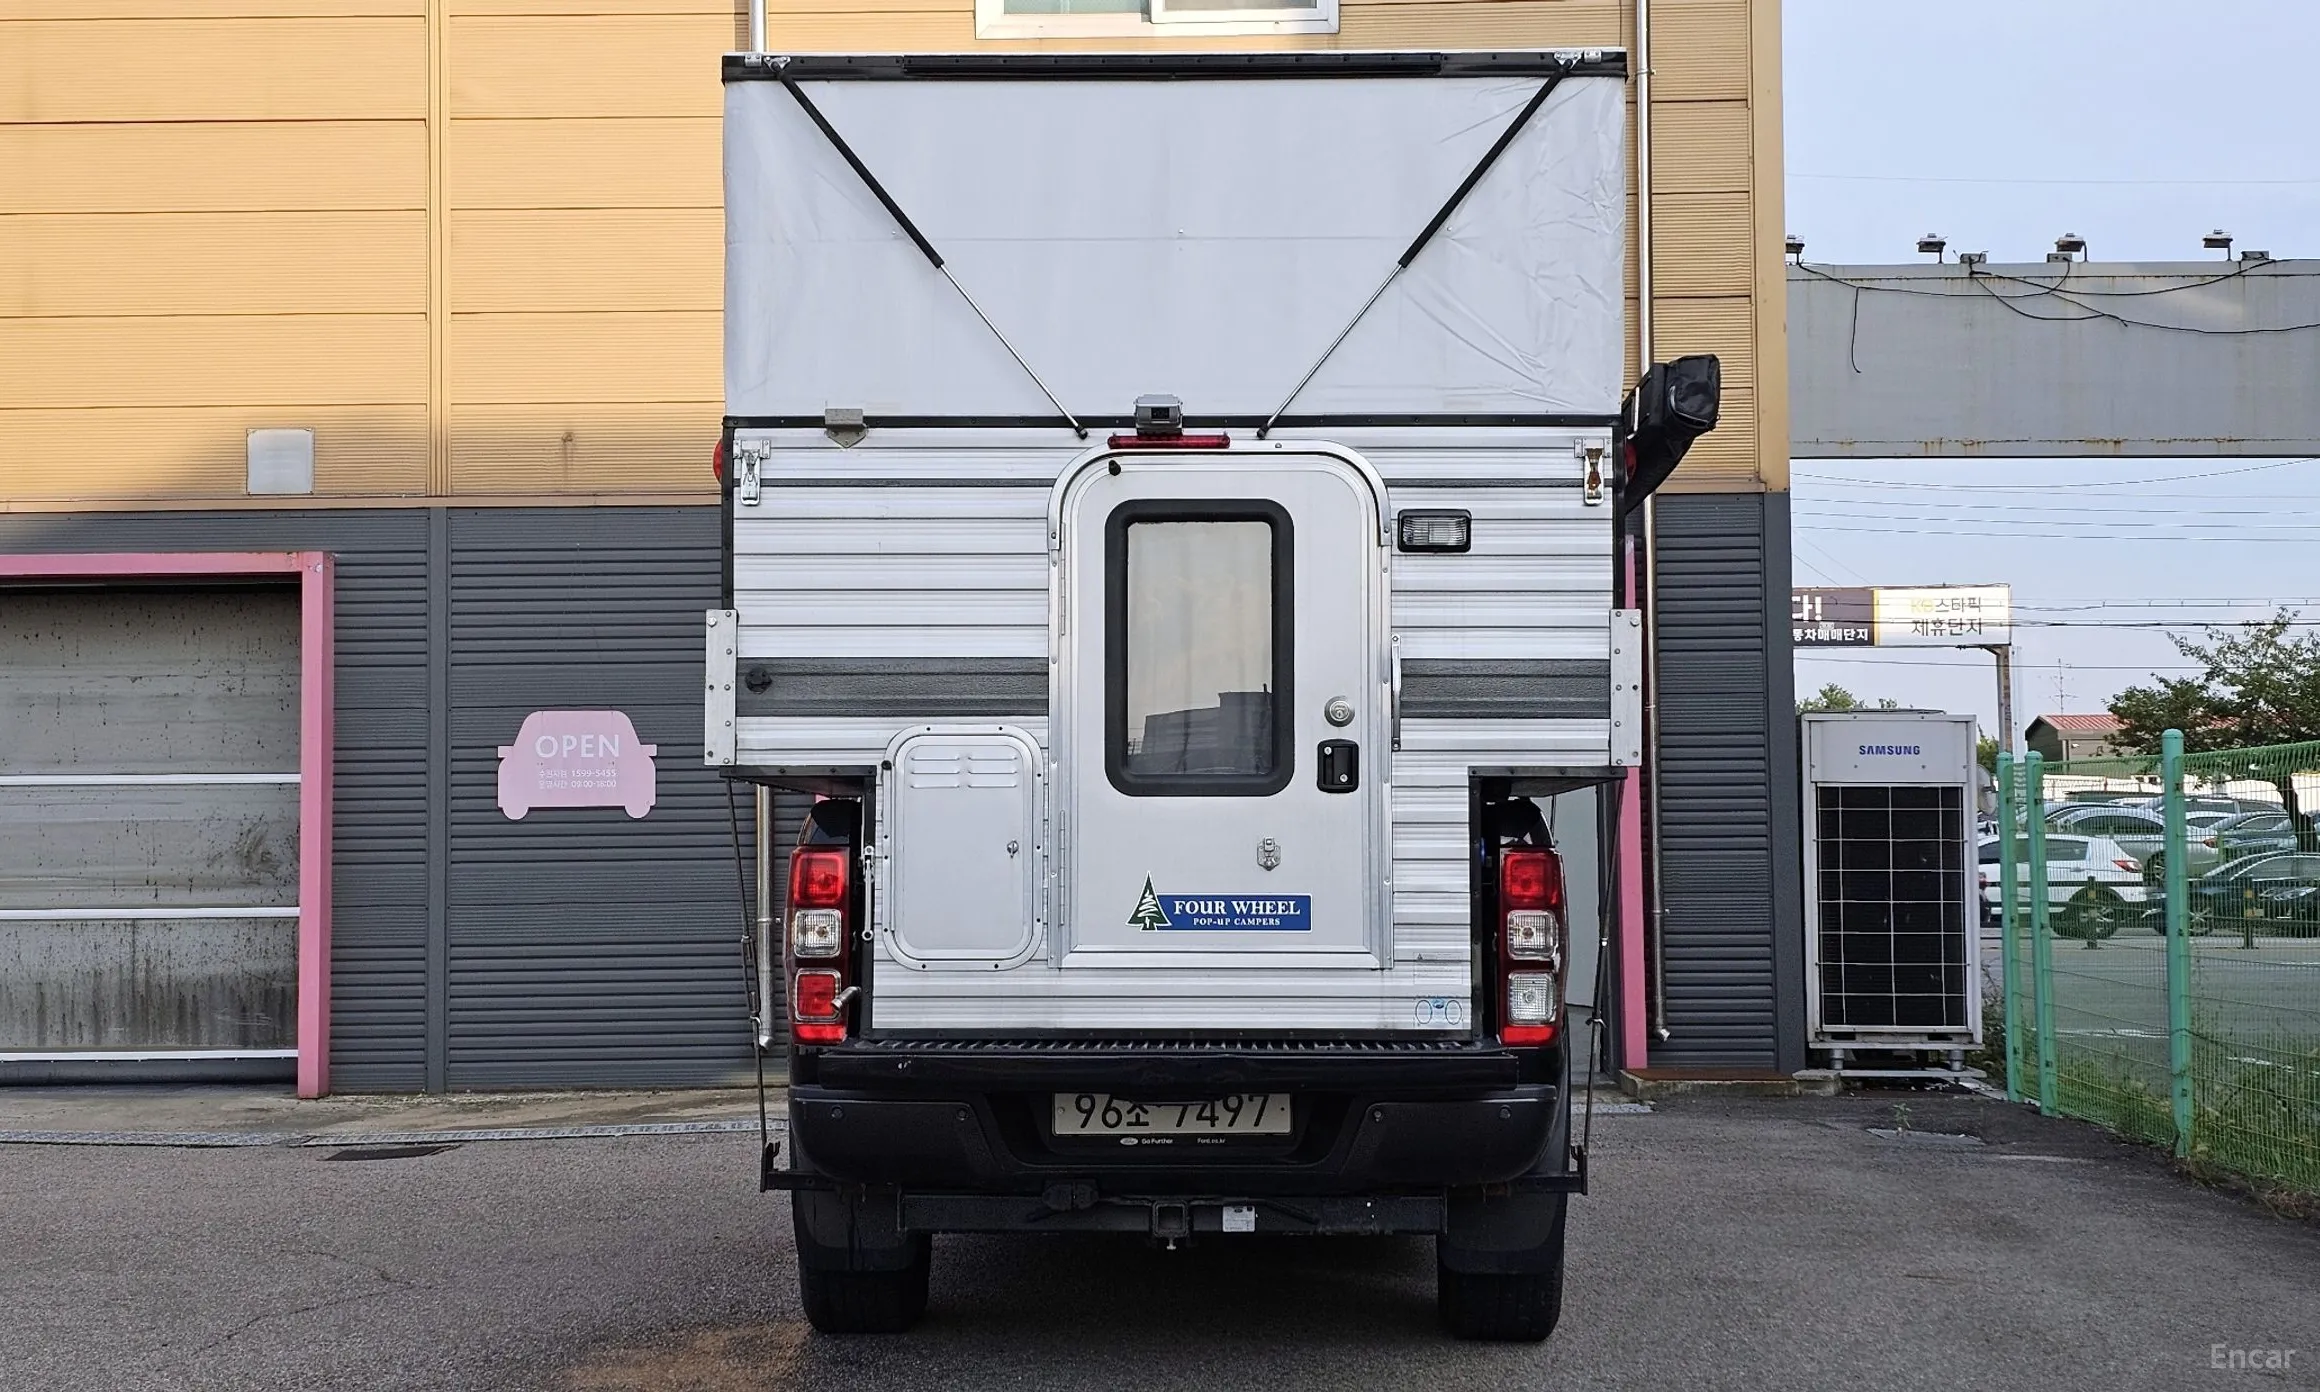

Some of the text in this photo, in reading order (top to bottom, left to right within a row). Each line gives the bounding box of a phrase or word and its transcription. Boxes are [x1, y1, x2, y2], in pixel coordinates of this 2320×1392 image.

[1911, 618, 1983, 636] 제휴단지
[535, 734, 620, 758] OPEN
[1859, 745, 1920, 755] SAMSUNG
[1173, 900, 1301, 915] FOUR WHEEL
[1193, 917, 1281, 926] POP-UP CAMPERS
[1174, 1094, 1270, 1128] 7497
